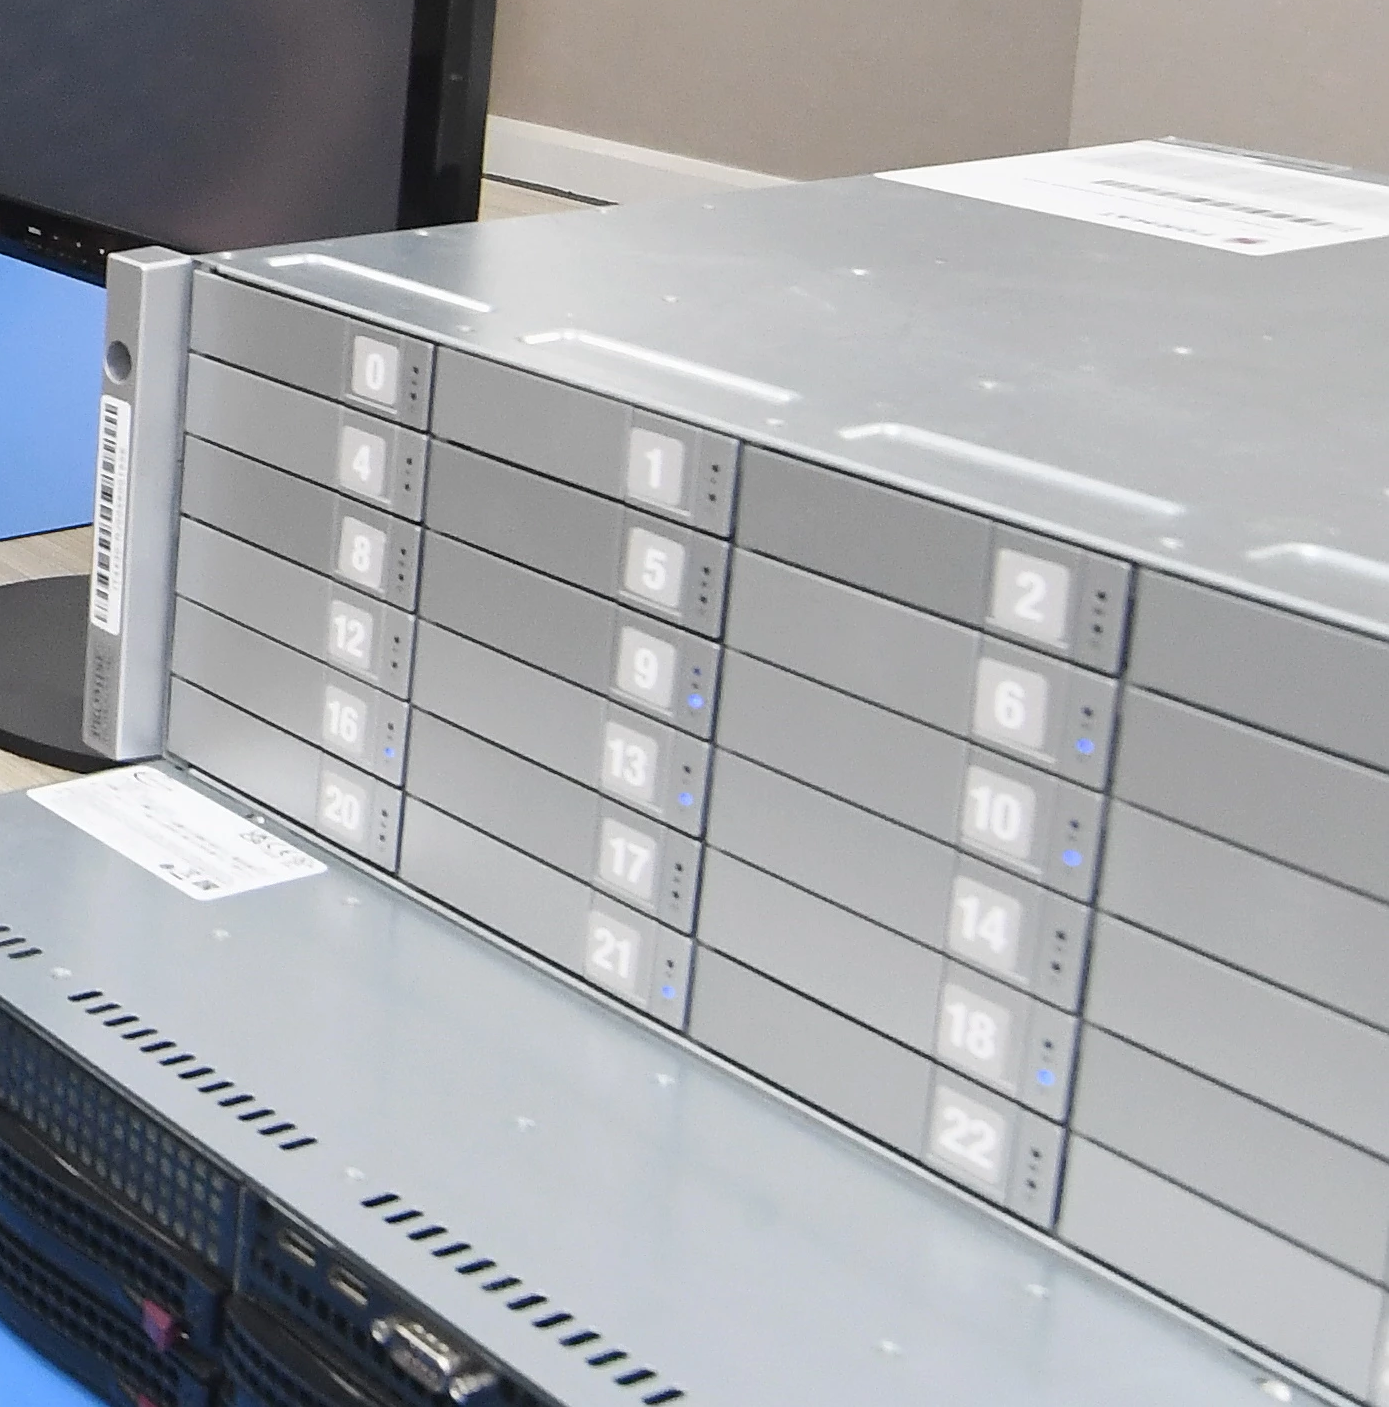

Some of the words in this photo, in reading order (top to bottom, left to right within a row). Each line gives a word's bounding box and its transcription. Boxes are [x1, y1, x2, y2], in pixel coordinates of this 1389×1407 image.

[365, 352, 386, 391] 0
[352, 444, 371, 482] 4
[643, 446, 663, 489] 1
[351, 534, 371, 572] 8
[642, 547, 668, 591] 5
[1014, 569, 1046, 623] 2
[333, 615, 366, 658] 12
[633, 646, 658, 689] 9
[326, 700, 358, 742] 16
[994, 679, 1027, 729] 6
[607, 738, 647, 787] 13
[321, 784, 360, 830] 20
[969, 784, 1021, 841] 10
[609, 837, 651, 884] 17
[956, 895, 1006, 953] 14
[591, 927, 630, 979] 21
[944, 1002, 997, 1059] 18
[938, 1105, 998, 1170] 22
